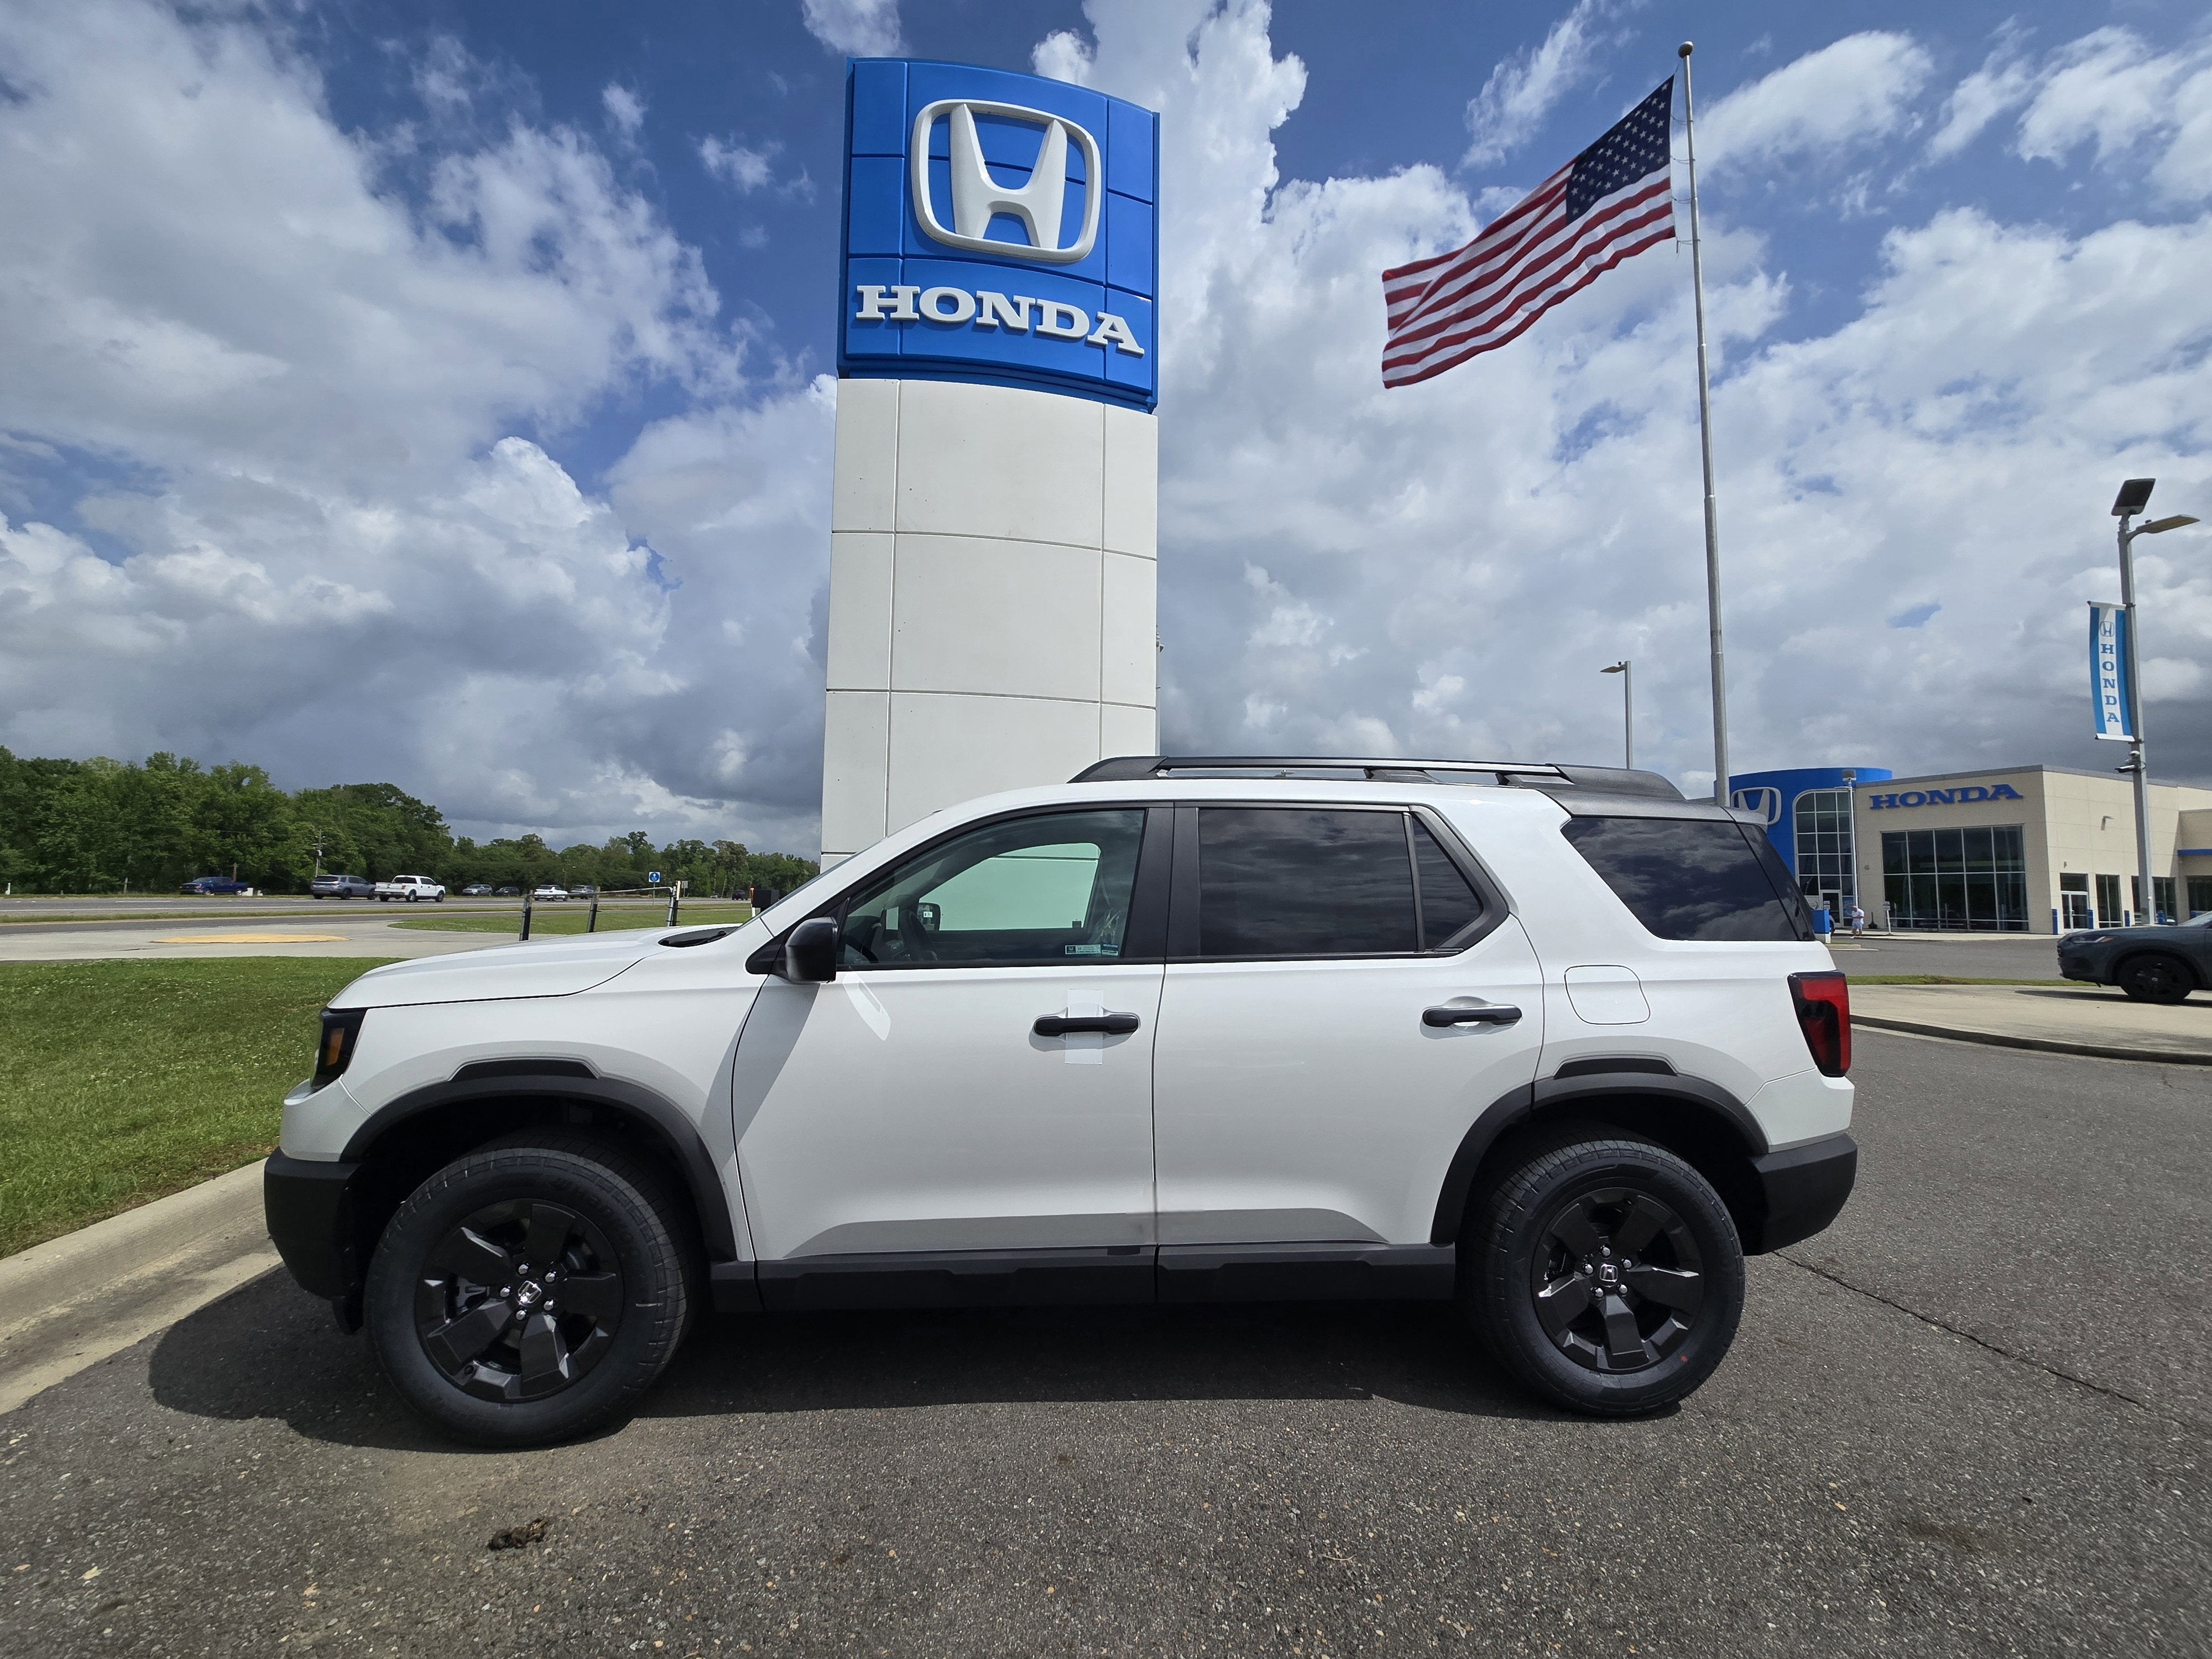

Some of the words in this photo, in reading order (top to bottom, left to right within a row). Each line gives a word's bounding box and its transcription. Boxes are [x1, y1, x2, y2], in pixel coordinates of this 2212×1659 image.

[855, 285, 1145, 358] HONDA
[2100, 644, 2120, 723] HONDA
[1869, 784, 2024, 810] HONDA
